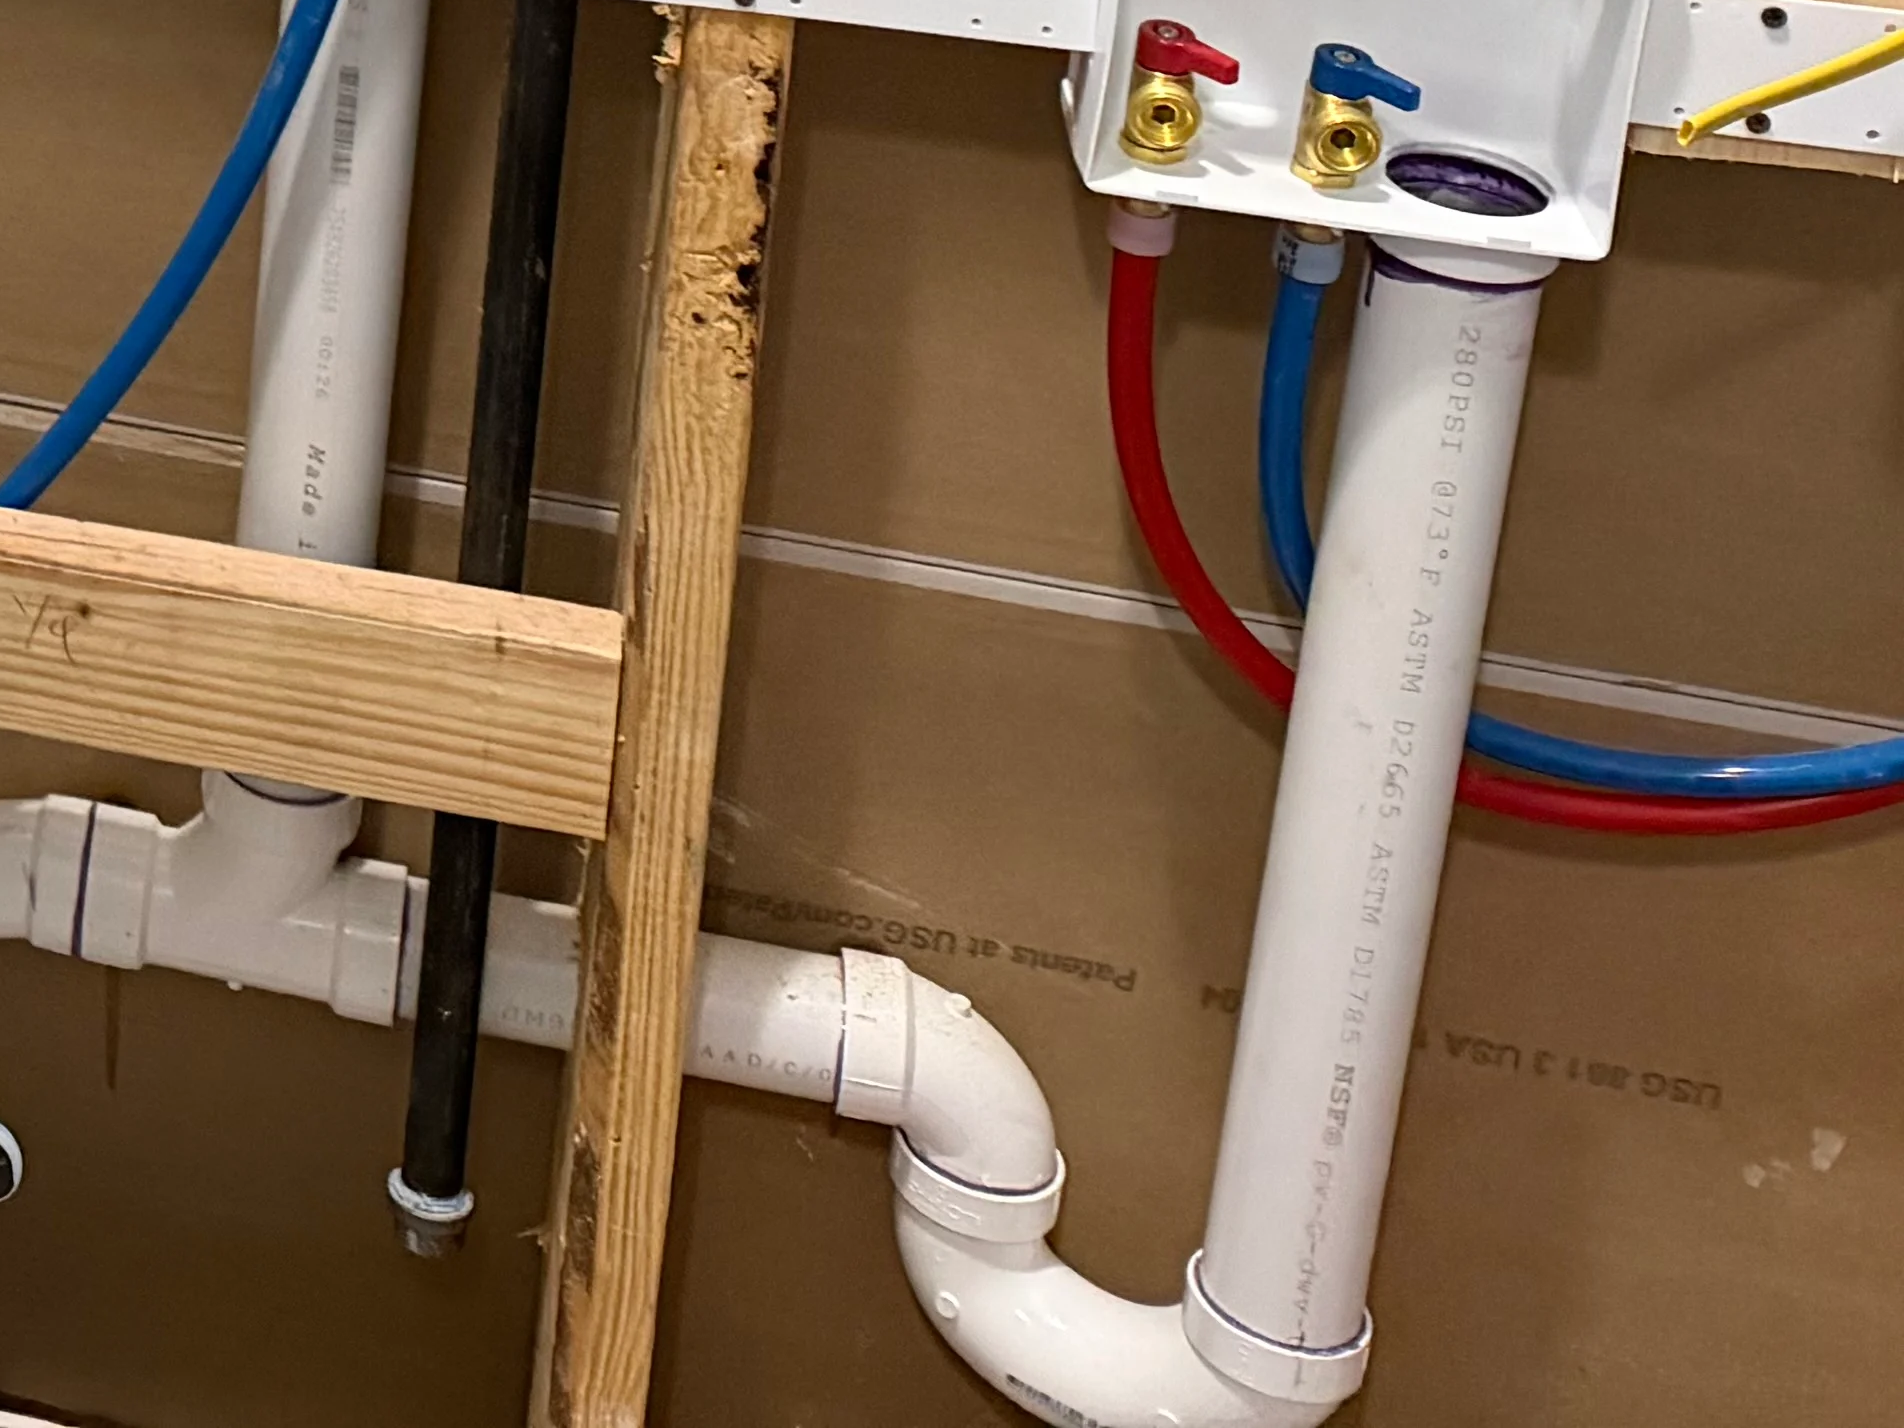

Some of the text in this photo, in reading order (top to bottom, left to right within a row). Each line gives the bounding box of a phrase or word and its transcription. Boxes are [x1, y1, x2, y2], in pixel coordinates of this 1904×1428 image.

[1440, 325, 1481, 454] 280PSI
[302, 442, 327, 517] Made
[1399, 609, 1434, 694] ASTM
[1379, 721, 1415, 820] D2665
[1361, 842, 1393, 928] ASTM
[967, 934, 1000, 962] at
[1009, 943, 1139, 993] Patents
[1338, 945, 1376, 1045] D1785
[1441, 1030, 1523, 1076] USA
[1639, 1071, 1723, 1111] USG
